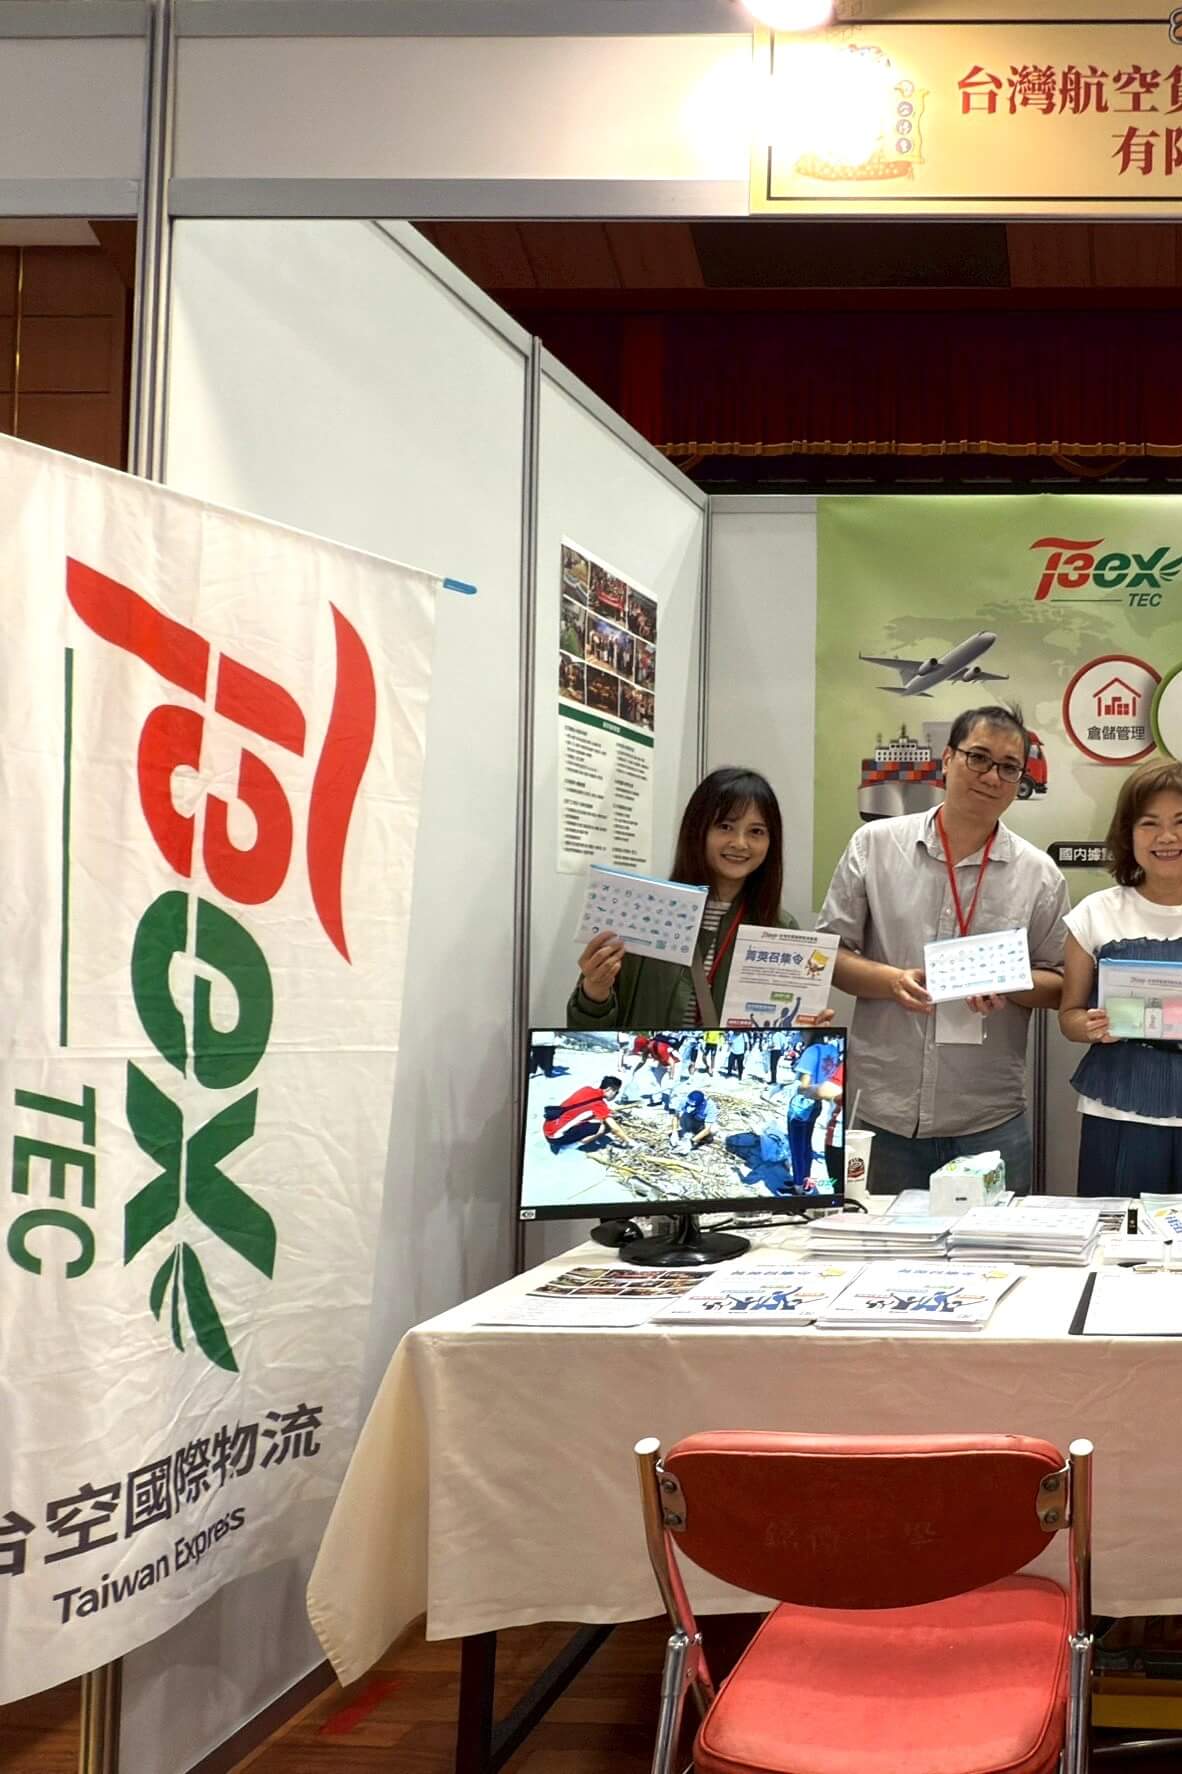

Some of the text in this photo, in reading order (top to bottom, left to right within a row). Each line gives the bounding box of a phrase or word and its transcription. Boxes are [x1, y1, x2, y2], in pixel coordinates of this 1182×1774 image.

[1129, 593, 1162, 607] TEC
[6, 1085, 96, 1281] TEC
[53, 1507, 246, 1624] Taiwan Express
